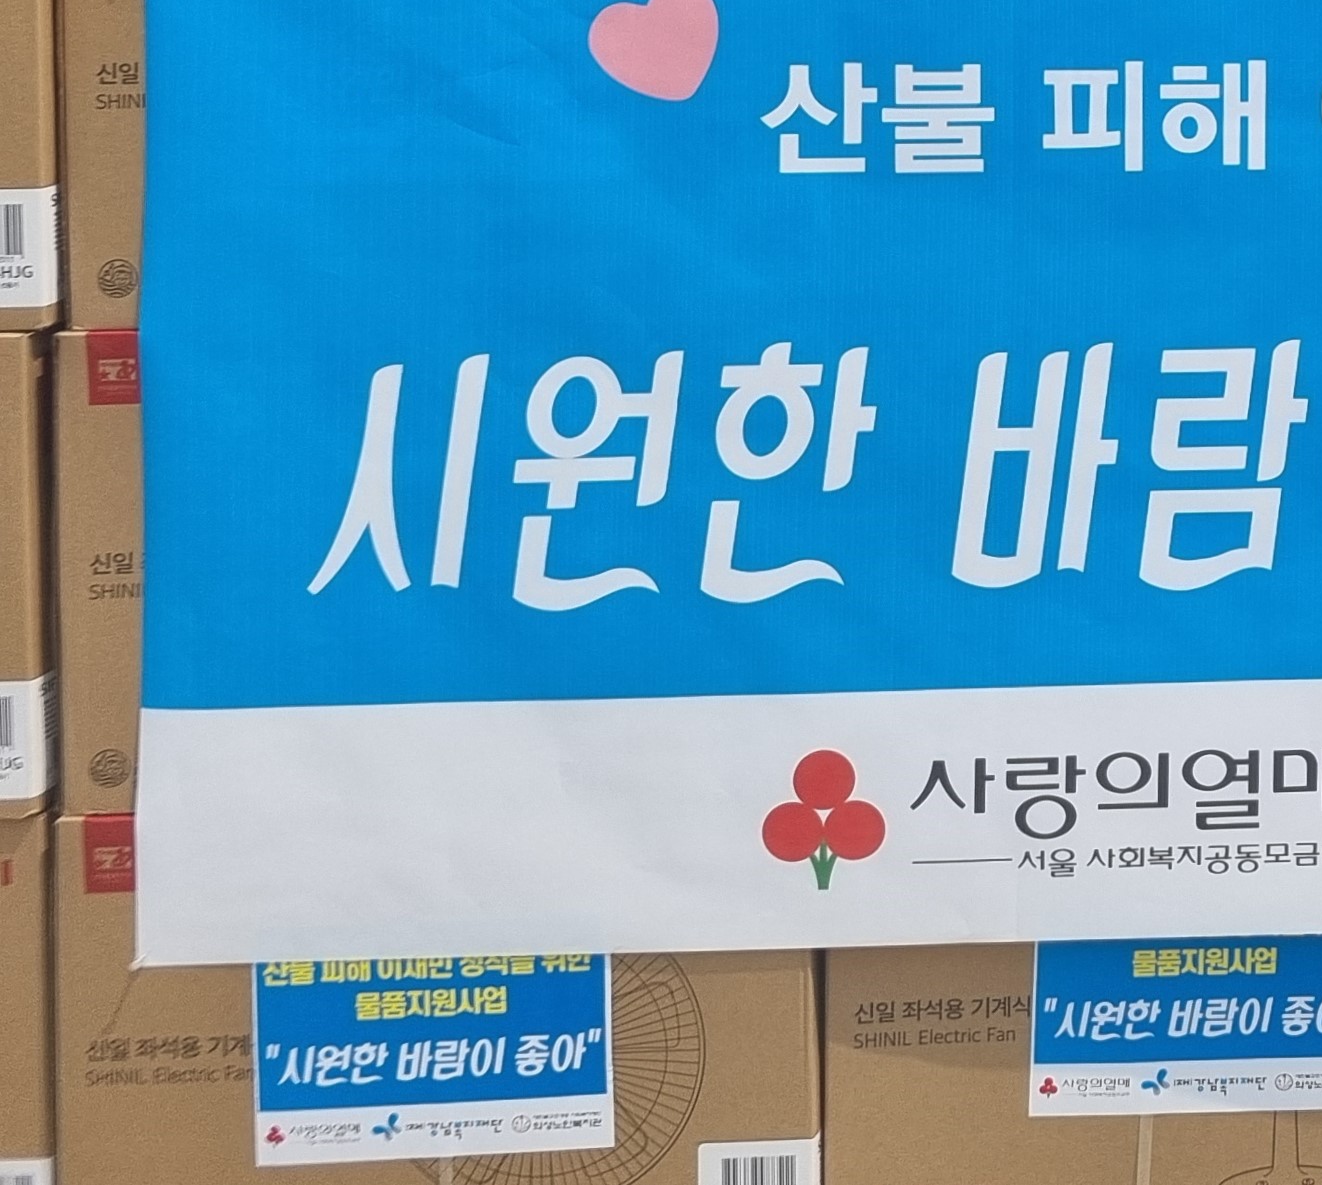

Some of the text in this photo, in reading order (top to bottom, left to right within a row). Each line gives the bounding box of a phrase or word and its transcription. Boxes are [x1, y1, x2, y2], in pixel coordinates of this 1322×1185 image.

[96, 62, 139, 85] 신일
[95, 93, 146, 110] SHINI
[761, 63, 994, 173] 산불
[1043, 60, 1266, 171] 피해
[308, 343, 876, 610] 시원한
[89, 551, 134, 575] 신일
[88, 583, 145, 600] SHINI
[1019, 849, 1076, 877] 서울
[1132, 947, 1278, 978] 물품지원사업
[355, 985, 508, 1022] 물품지원사업
[855, 995, 1032, 1025] 신일 좌석용 기계식
[1043, 996, 1161, 1042] "시원한
[1167, 996, 1274, 1038] 바람이
[854, 1026, 1016, 1049] SHINIL Electric Fan
[265, 1027, 602, 1088] "시원한 바람이 좋아"
